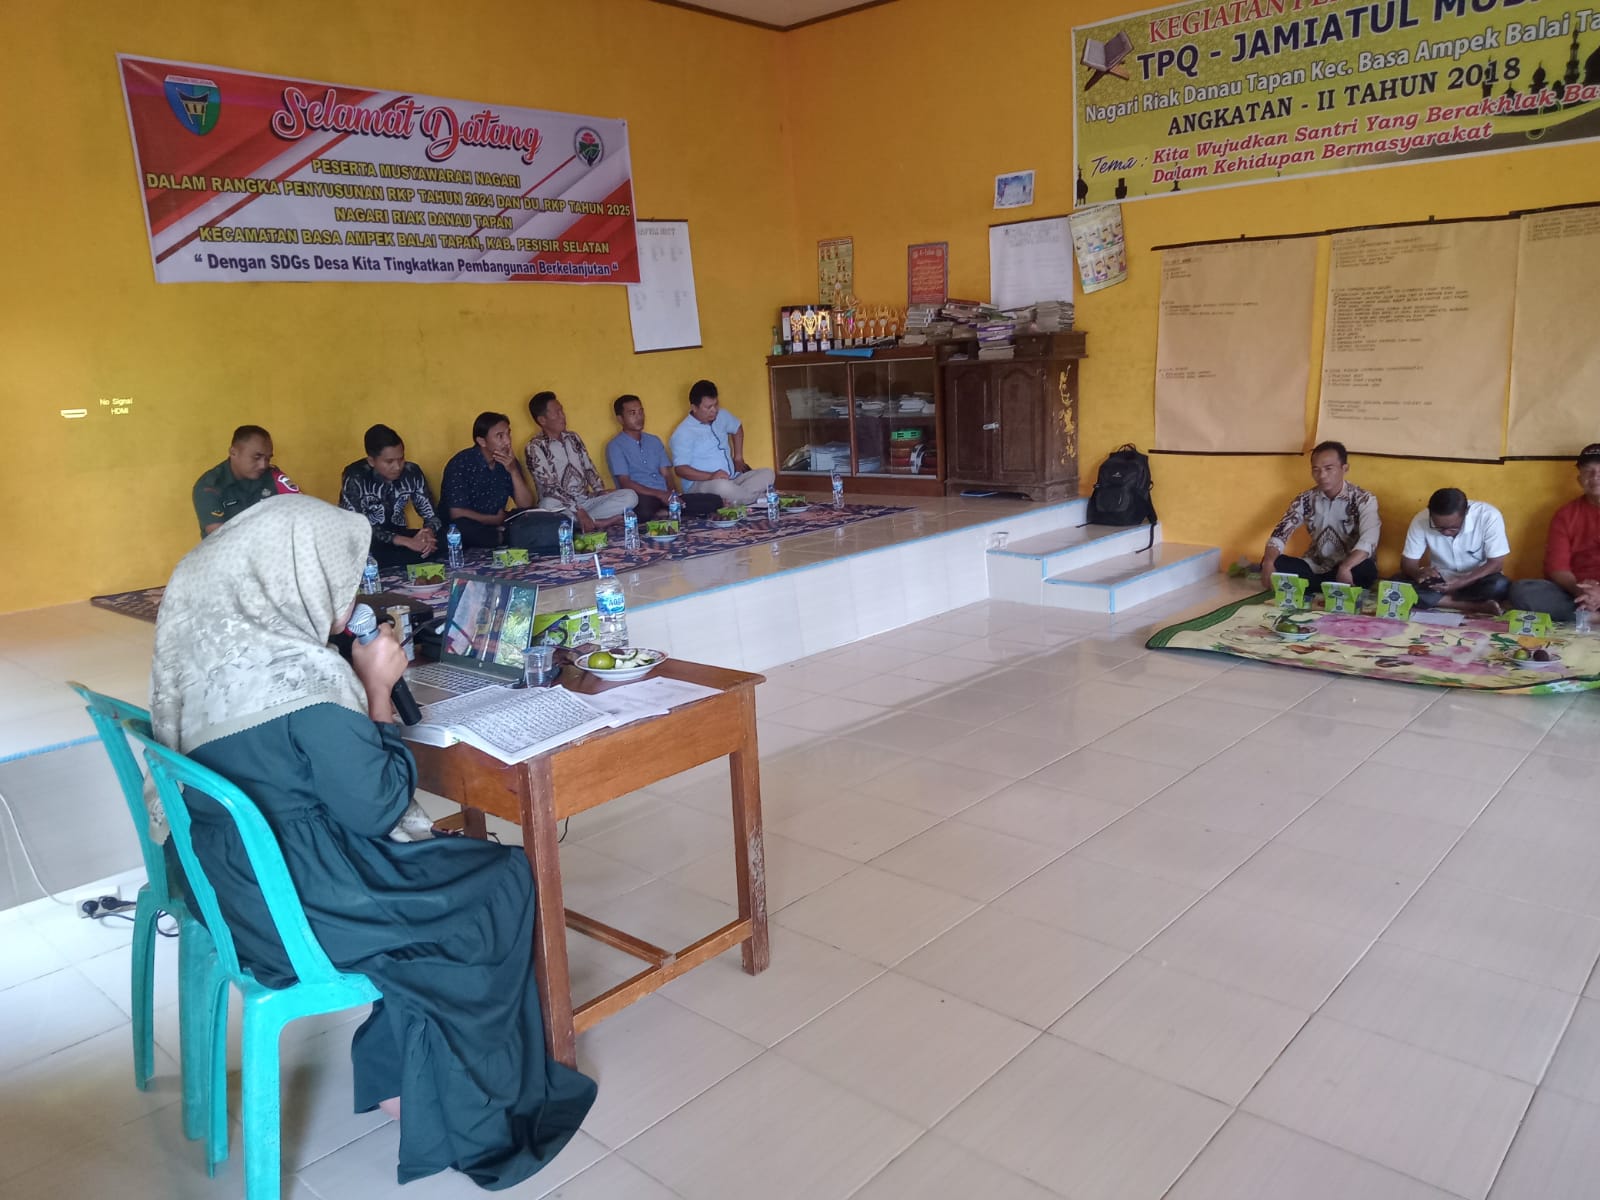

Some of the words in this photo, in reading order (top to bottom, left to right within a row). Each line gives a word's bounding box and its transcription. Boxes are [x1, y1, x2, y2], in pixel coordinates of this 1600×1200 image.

[1137, 44, 1199, 80] TPQ
[1231, 1, 1419, 62] JAMIATUL
[1149, 0, 1286, 43] KEGIATAN
[1085, 103, 1139, 123] Nagari
[1142, 92, 1179, 112] Riak
[1183, 81, 1242, 104] Danau
[1246, 70, 1305, 95] Tapan
[1311, 58, 1353, 80] Kec.
[1358, 50, 1409, 72] Basa
[1415, 26, 1500, 62] Ampek
[1505, 12, 1570, 46] Balai
[1168, 96, 1293, 136] ANGKATAN
[1317, 89, 1336, 111] II
[1344, 72, 1438, 107] TAHUN
[1447, 57, 1521, 91] 2018
[270, 86, 426, 141] Selamat
[419, 105, 546, 166] Datang
[1152, 148, 1190, 165] Kita
[1196, 133, 1288, 158] Wujudkan
[1294, 118, 1358, 143] Santri
[1366, 111, 1419, 132] Yang
[1426, 89, 1556, 125] Berakhlak
[1562, 84, 1600, 103] Ba
[311, 159, 377, 178] PESERTA
[379, 164, 474, 185] MUSYAWARAH
[475, 172, 521, 188] NAGARI
[1091, 155, 1138, 177] Tema
[1152, 164, 1208, 184] Dalam
[1213, 149, 1316, 176] Kehidupan
[1321, 122, 1493, 161] Bermasyarakat
[146, 173, 206, 191] DALAM
[210, 176, 281, 194] RANGKA
[283, 181, 384, 201] PENYUSUNAN
[387, 187, 414, 203] RKP
[417, 189, 463, 206] TAHUN
[465, 193, 495, 208] 2024
[496, 196, 521, 209] DAN
[569, 200, 605, 215] TAHUN
[607, 203, 631, 216] 2025
[199, 226, 298, 244] KECAMATAN
[301, 230, 342, 245] BASA
[344, 231, 394, 246] AMPEK
[396, 232, 437, 247] BALAI
[440, 234, 485, 251] TAPAN,
[486, 238, 514, 250] KAB.
[517, 239, 561, 252] PESISIR
[563, 241, 610, 254] SELATAN
[334, 207, 389, 224] NAGARI
[392, 210, 425, 226] RIAK
[428, 212, 471, 228] DANAU
[474, 214, 514, 230] TAPAN
[207, 253, 266, 272] Dengan
[270, 254, 310, 270] SDGs
[314, 255, 349, 270] Desa
[353, 256, 381, 271] Kita
[384, 256, 455, 275] Tingkatkan
[457, 258, 536, 276] Pembangunan
[538, 260, 611, 277] Berkelanjutan
[99, 398, 110, 406] No
[112, 397, 133, 406] Signal
[110, 407, 129, 415] HDMI
